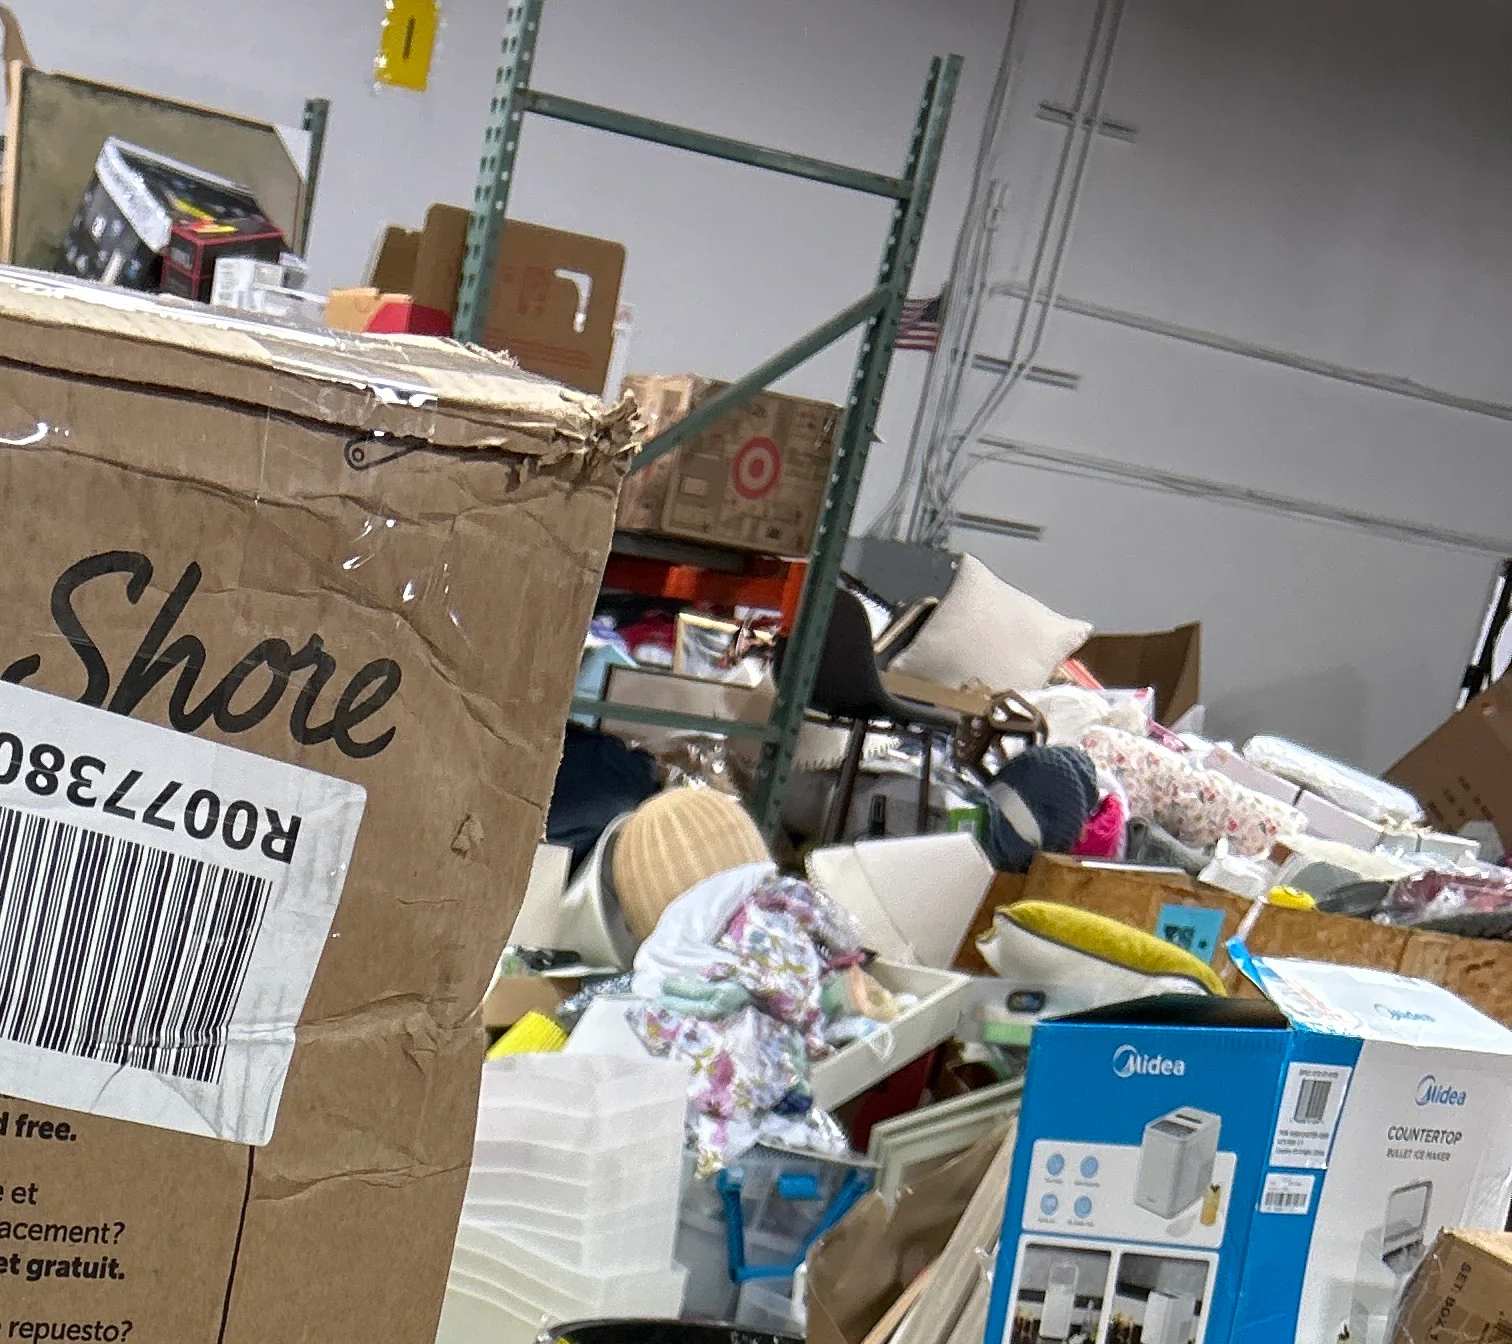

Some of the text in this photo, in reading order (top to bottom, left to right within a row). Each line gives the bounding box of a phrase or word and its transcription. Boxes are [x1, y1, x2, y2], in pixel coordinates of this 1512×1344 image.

[5, 549, 402, 752] Shore
[1113, 1044, 1185, 1077] Midea
[1415, 1074, 1466, 1107] Midea
[15, 1113, 76, 1141] free.
[1388, 1125, 1462, 1145] COUNTERTOP
[11, 1182, 38, 1205] et
[26, 1255, 124, 1281] gratuit.
[8, 1320, 132, 1344] repuesto?
